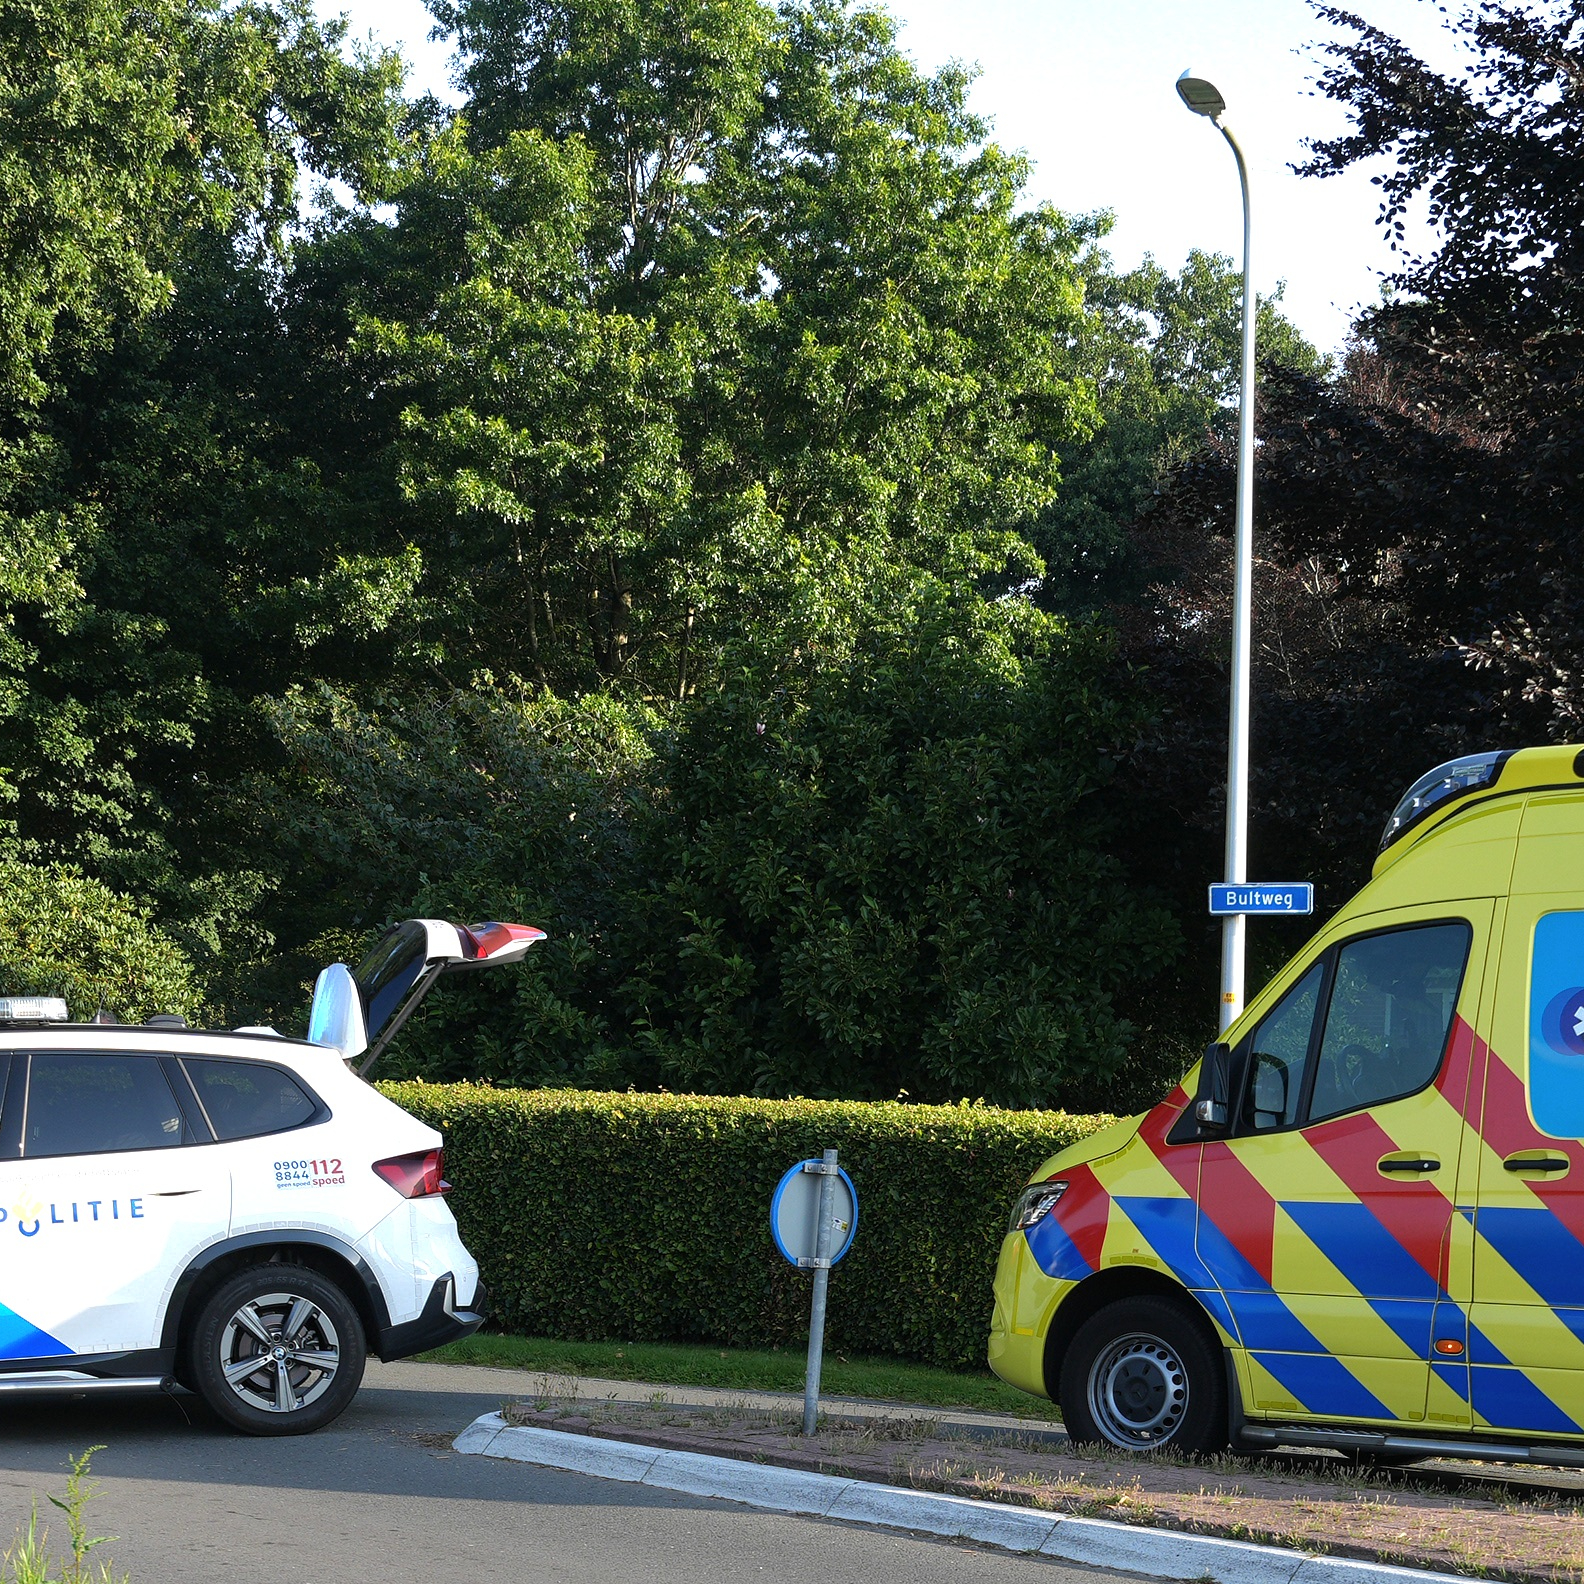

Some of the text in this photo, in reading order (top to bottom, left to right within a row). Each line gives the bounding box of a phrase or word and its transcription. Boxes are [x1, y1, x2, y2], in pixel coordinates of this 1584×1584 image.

[1226, 891, 1293, 909] Bultweg
[274, 1160, 308, 1171] 0900
[309, 1158, 344, 1175] 112
[275, 1170, 310, 1181] 8844
[312, 1175, 346, 1187] spoed
